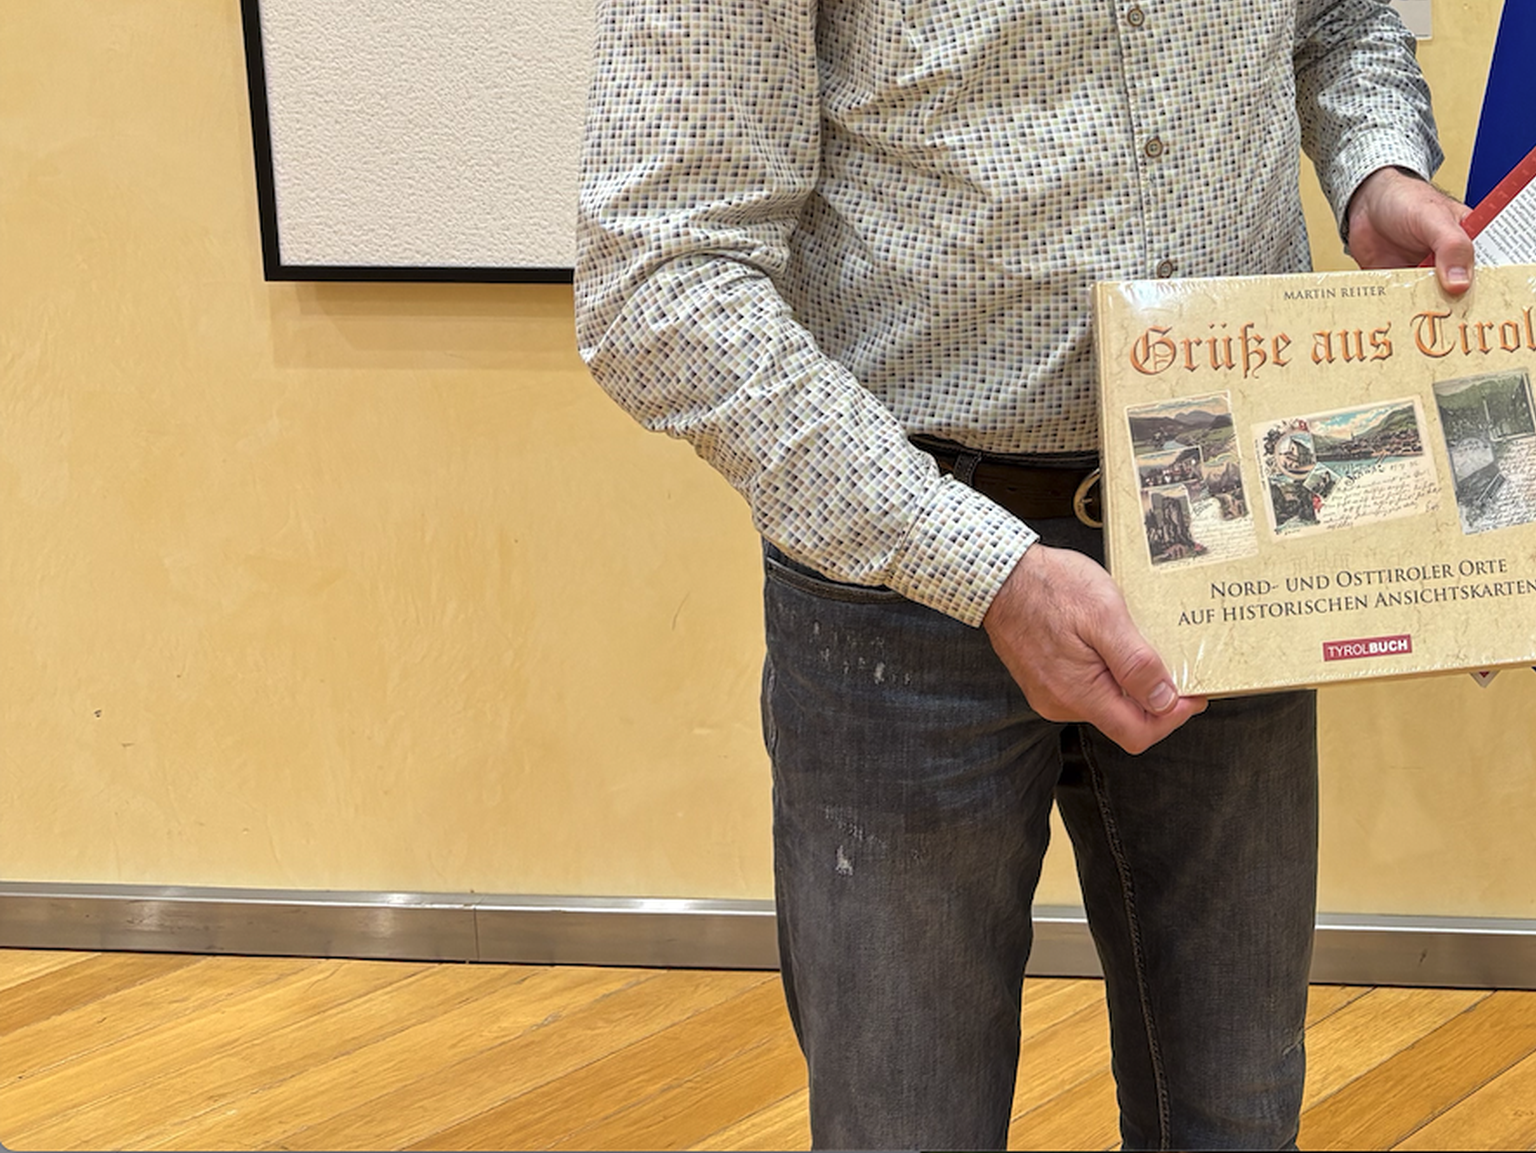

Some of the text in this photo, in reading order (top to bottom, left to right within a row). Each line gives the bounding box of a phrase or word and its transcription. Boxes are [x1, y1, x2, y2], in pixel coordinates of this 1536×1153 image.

[1283, 286, 1387, 301] MARTIN REITER
[1129, 322, 1292, 379] Grüße
[1311, 321, 1394, 365] aus
[1210, 579, 1279, 599] NORD-
[1458, 558, 1508, 577] ORTE
[1178, 608, 1215, 626] AUF
[1223, 594, 1369, 622] HISTORISCHEN
